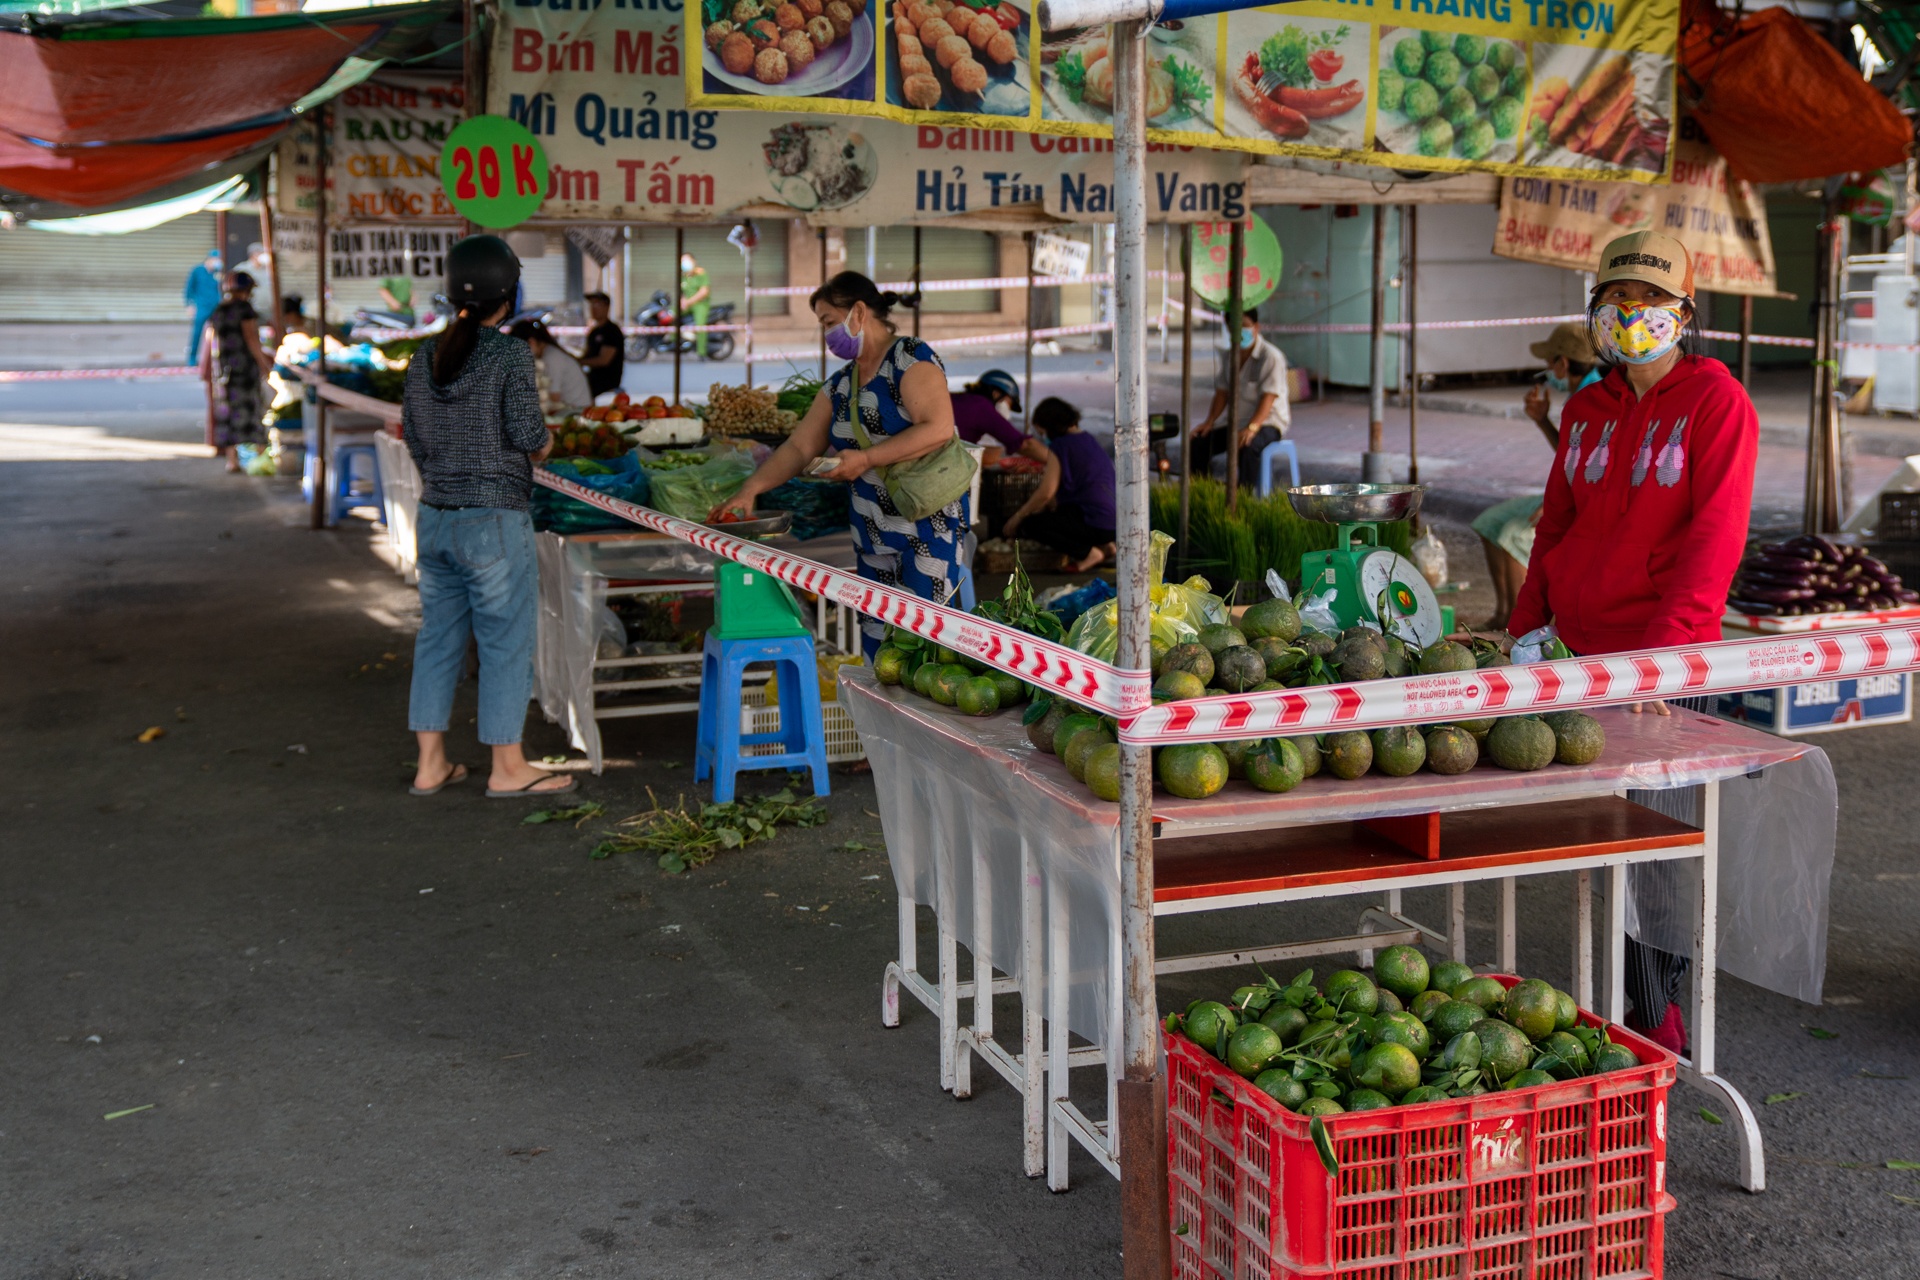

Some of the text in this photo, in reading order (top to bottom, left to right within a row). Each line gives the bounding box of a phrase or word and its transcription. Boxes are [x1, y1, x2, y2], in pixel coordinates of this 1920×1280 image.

[1523, 0, 1614, 40] TRỌN
[512, 27, 595, 73] Bún
[345, 117, 412, 141] RAU
[508, 91, 719, 151] Mì Quảng
[452, 143, 539, 200] 20 K
[616, 156, 714, 205] Tấm
[348, 187, 423, 215] NƯỚC
[916, 165, 967, 212] Hủ
[1060, 172, 1114, 213] Na
[1155, 172, 1246, 219] Vang
[1551, 227, 1593, 256] CANH
[1748, 649, 1760, 658] KHU
[1773, 643, 1787, 655] CẤM
[1788, 643, 1799, 653] VÀO
[1749, 655, 1800, 668] NOT ALLOWED AREA
[1405, 675, 1461, 690] KHU VỰC CẤM VÀO
[1406, 688, 1463, 700] NOT ALLOWED AREA
[1794, 682, 1841, 707] TREAT
[1855, 674, 1901, 700] SUPER
